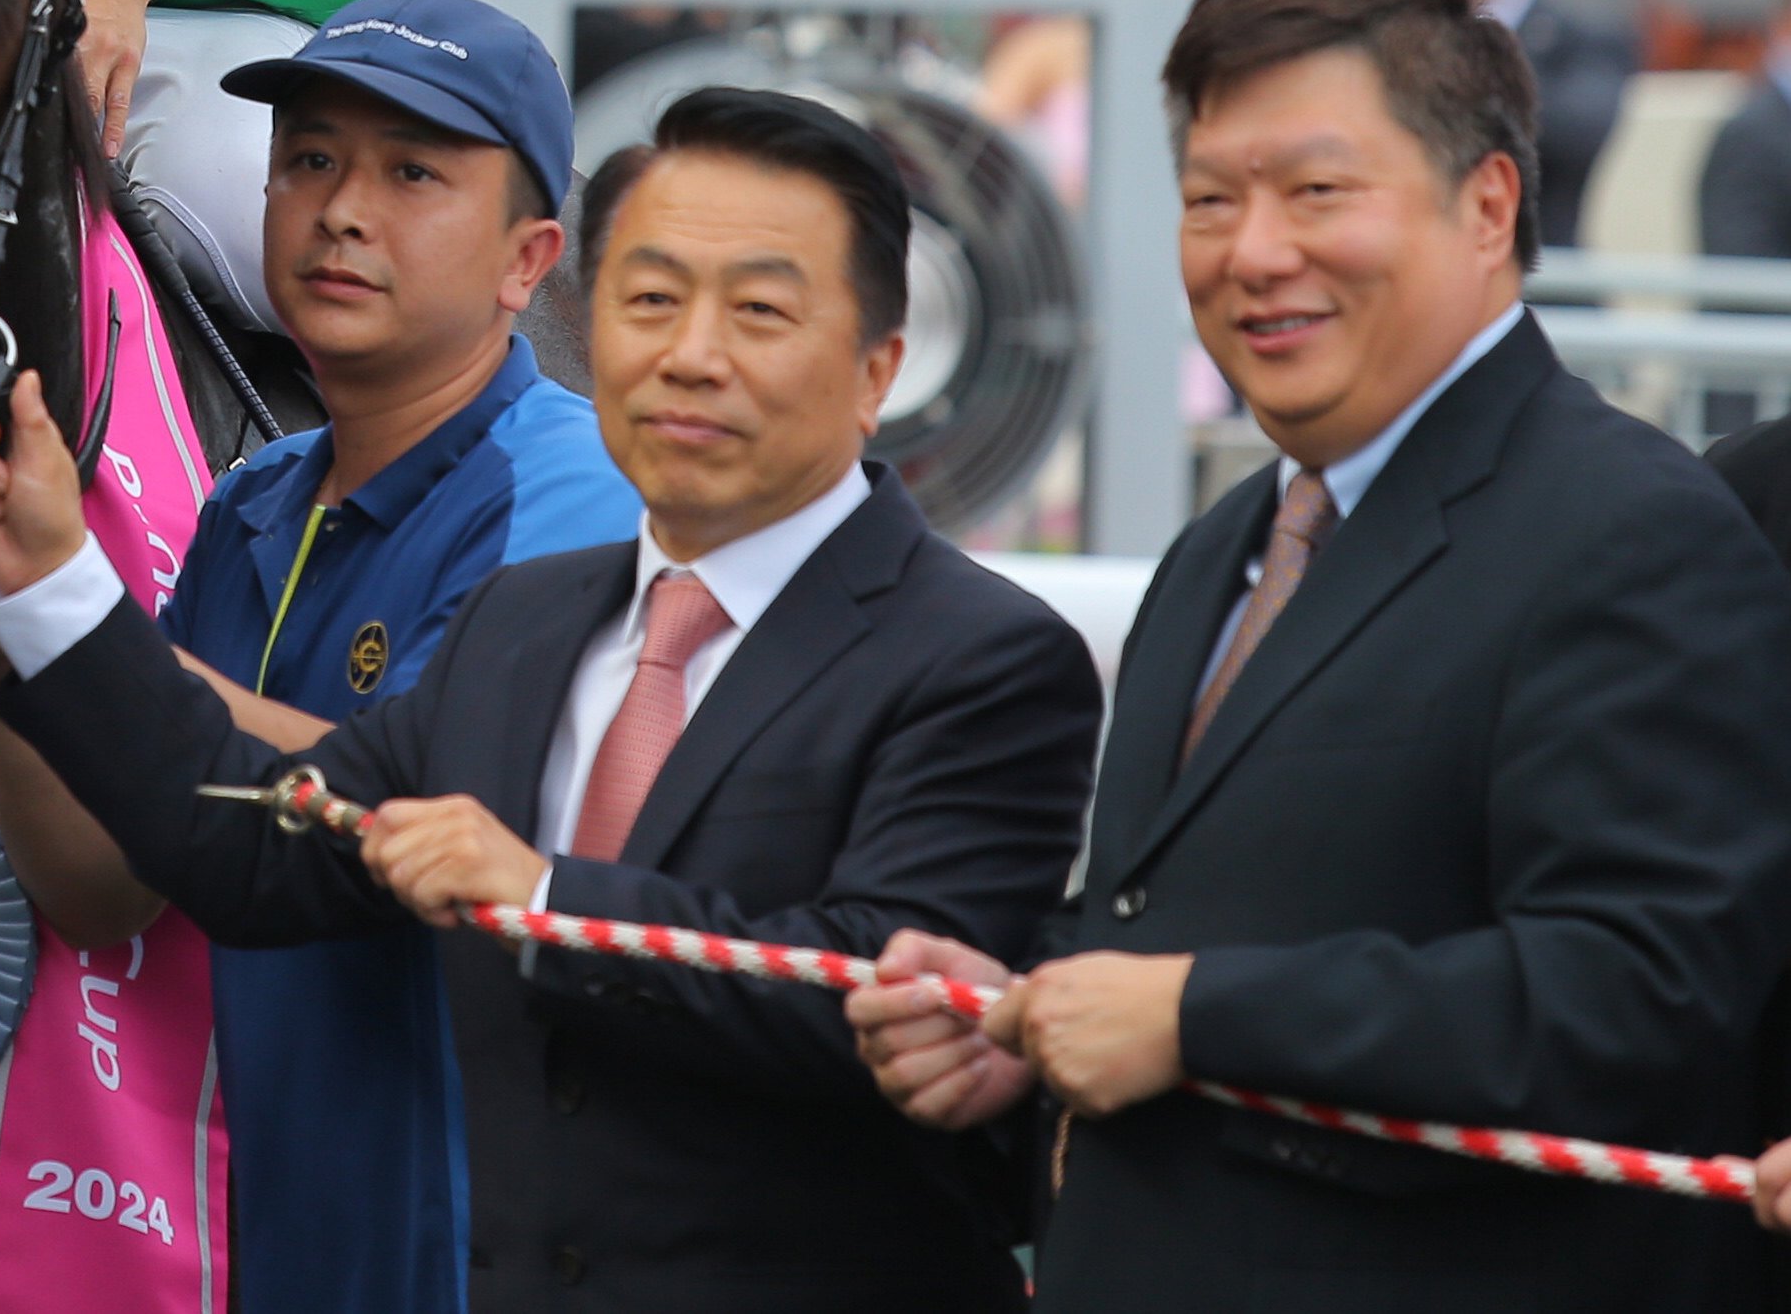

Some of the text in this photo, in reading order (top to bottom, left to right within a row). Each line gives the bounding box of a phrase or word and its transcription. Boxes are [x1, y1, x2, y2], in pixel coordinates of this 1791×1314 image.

[394, 25, 438, 48] Jockey
[439, 40, 468, 60] Club
[23, 1159, 174, 1246] 2024
